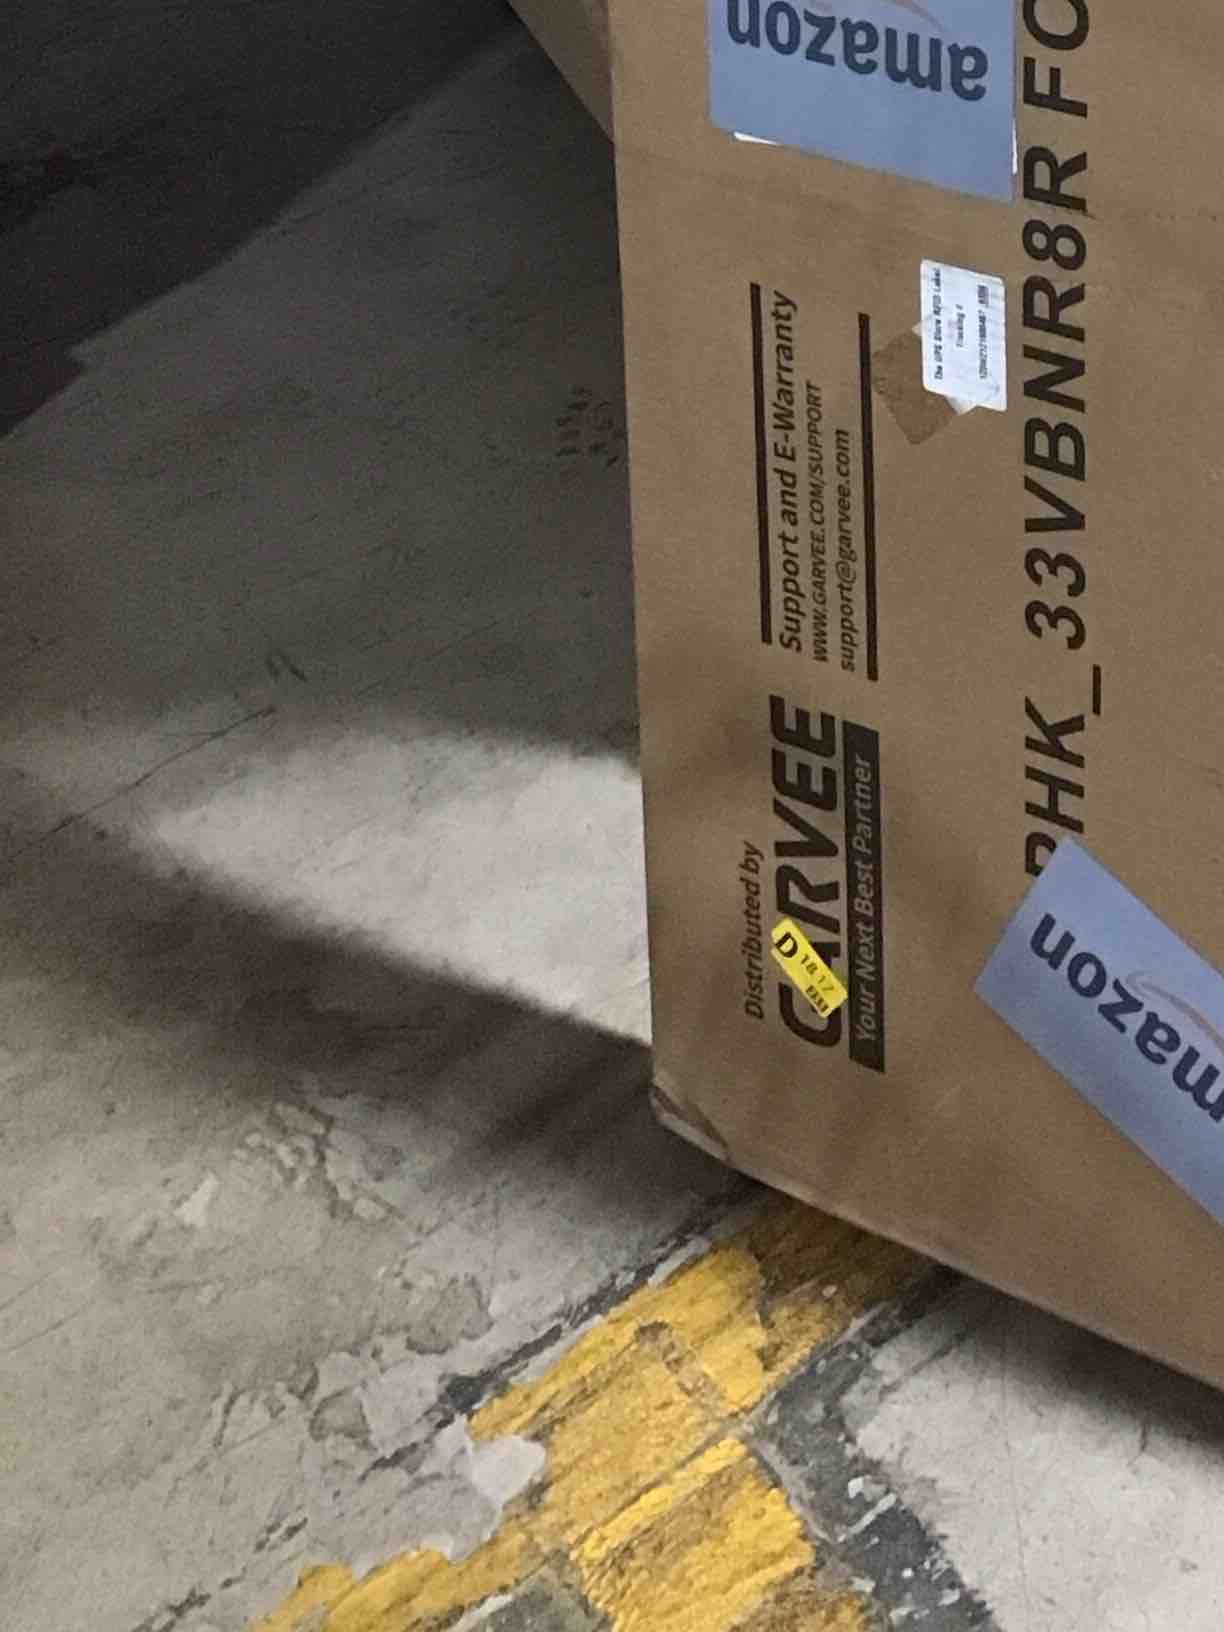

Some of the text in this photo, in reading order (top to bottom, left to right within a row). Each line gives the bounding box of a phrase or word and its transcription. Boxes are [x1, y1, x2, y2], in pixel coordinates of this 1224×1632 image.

[769, 289, 806, 653] Support and E-Warranty
[805, 380, 829, 663] WWW.GARVEE.COM/SUPPORT
[833, 428, 858, 672] support@garvee.com
[740, 839, 765, 1020] Distributed by
[769, 693, 842, 1048] GRVEE
[851, 753, 878, 1042] Your Next Best Partner
